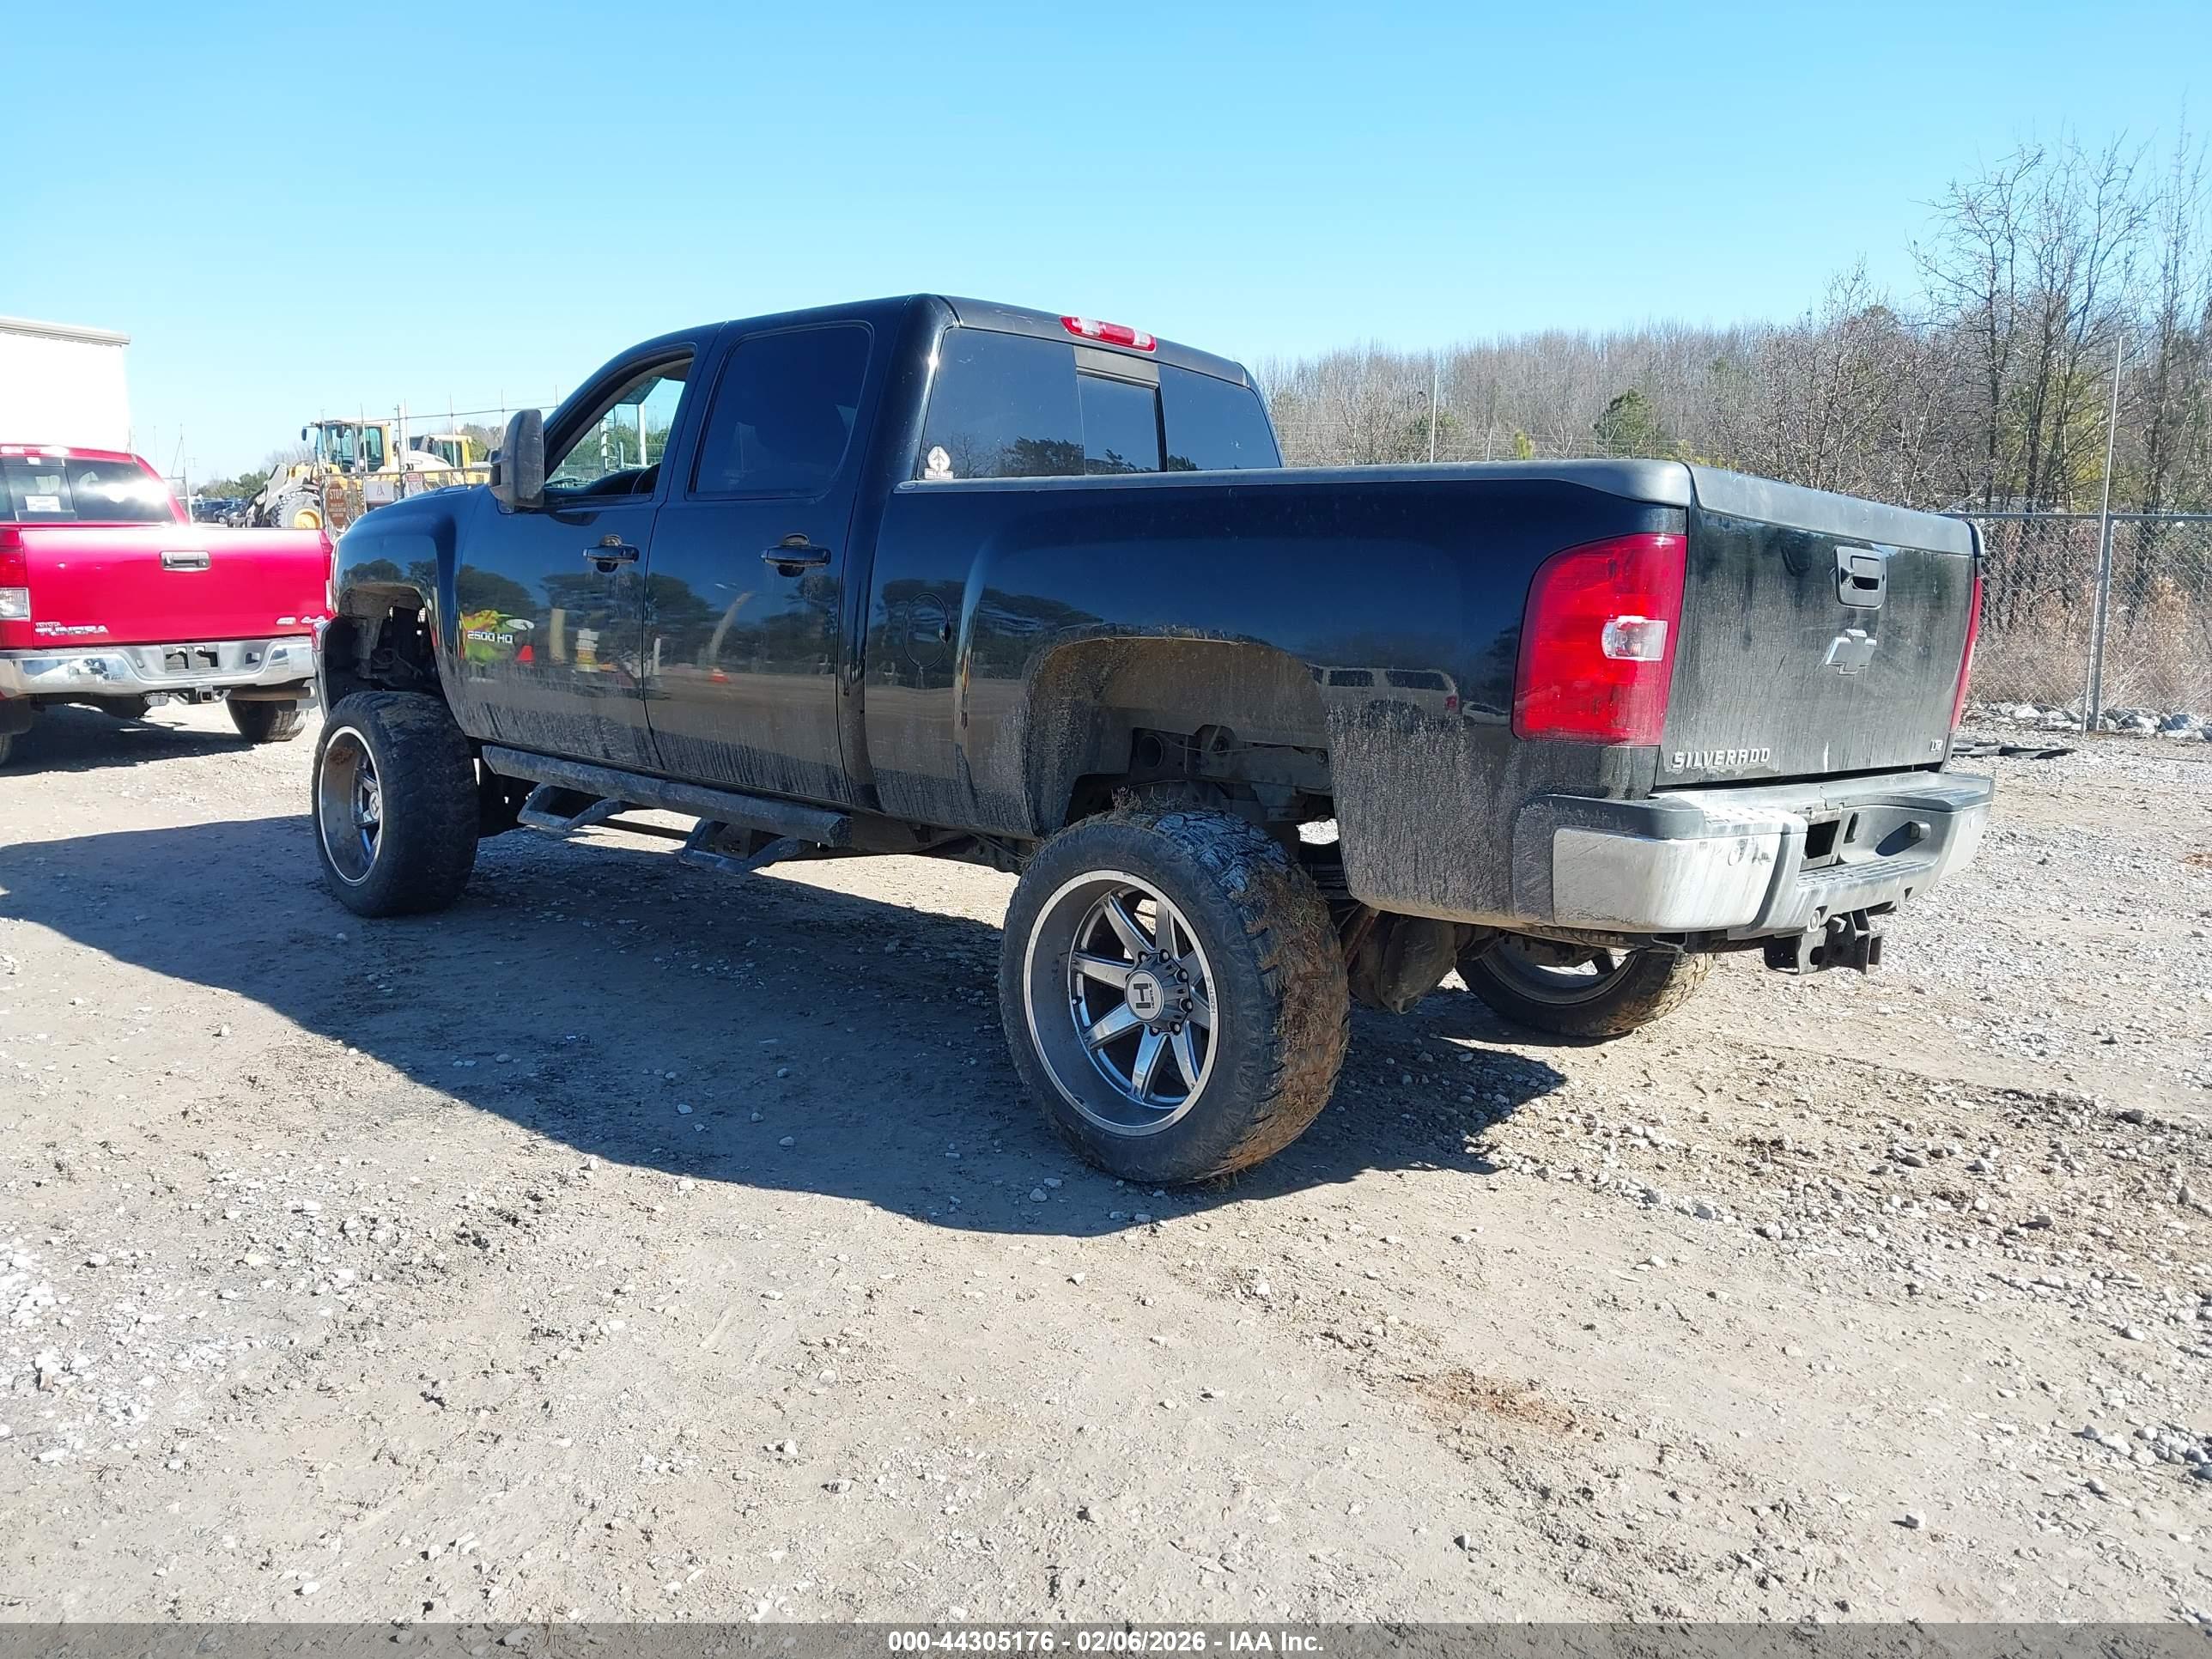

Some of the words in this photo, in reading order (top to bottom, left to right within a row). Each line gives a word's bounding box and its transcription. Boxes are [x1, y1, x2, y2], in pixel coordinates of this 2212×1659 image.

[329, 488, 343, 500] STOP
[467, 630, 495, 642] 2500
[1671, 747, 1770, 769] SILVERADO
